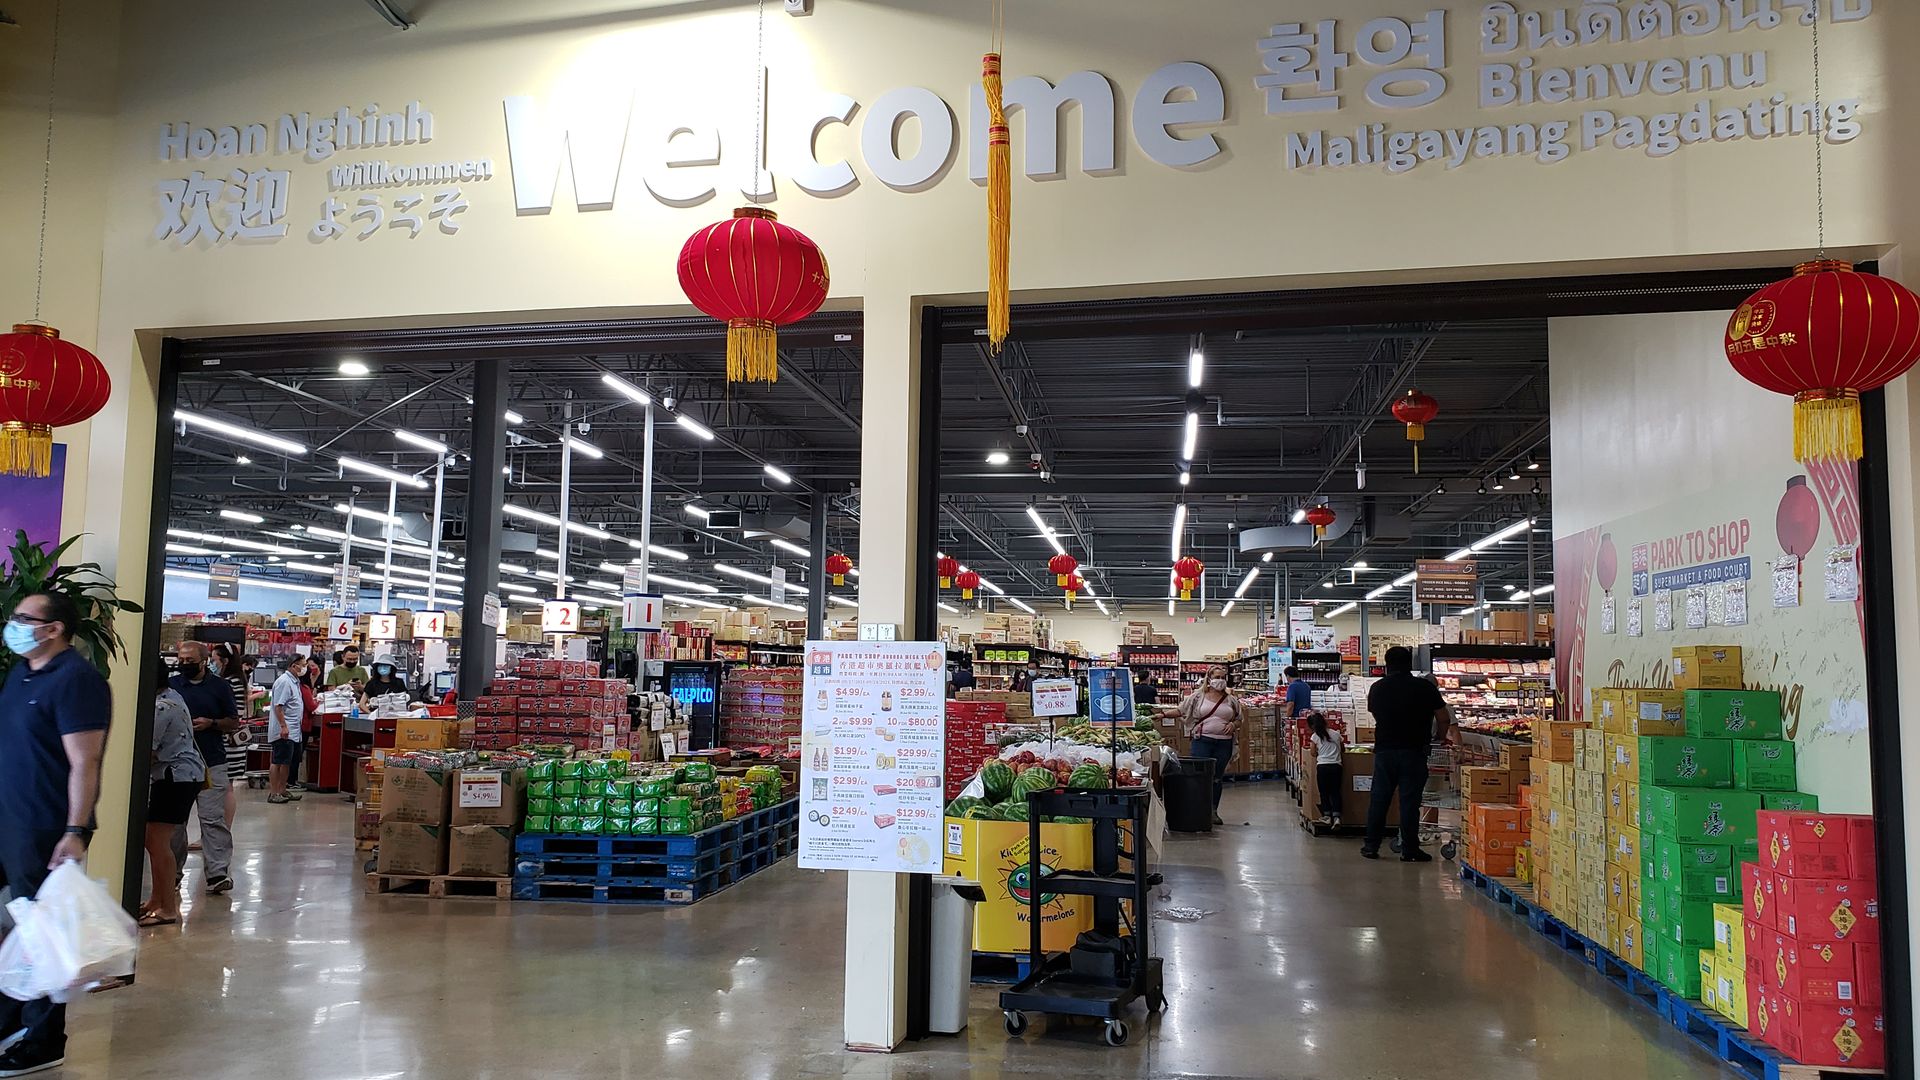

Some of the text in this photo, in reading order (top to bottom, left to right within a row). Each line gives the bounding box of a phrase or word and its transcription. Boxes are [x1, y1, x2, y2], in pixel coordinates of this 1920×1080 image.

[1256, 9, 1447, 115] 환영
[1481, 50, 1767, 107] Bienvenu
[159, 100, 433, 162] Hoan Nghinh
[502, 62, 1226, 216] Welcome
[1285, 94, 1861, 172] Maligayang Pagdating
[330, 158, 493, 187] Willkommen
[158, 167, 291, 244] 欢迎
[310, 188, 470, 238] ようこそ
[1651, 518, 1750, 571] PARK TO SHOP
[1462, 564, 1474, 574] 5
[1654, 572, 1695, 589] SUPERMARKET
[1704, 567, 1722, 580] FOOD
[1724, 562, 1748, 577] COURT
[380, 620, 389, 633] 5
[428, 618, 438, 633] 4
[559, 607, 571, 625] 2
[646, 603, 652, 623] 1
[338, 622, 348, 635] 6
[673, 687, 713, 703] CALPICO
[832, 716, 839, 725] 2
[849, 717, 873, 726] $9.99
[887, 717, 898, 726] 10
[908, 717, 938, 727] $80.00
